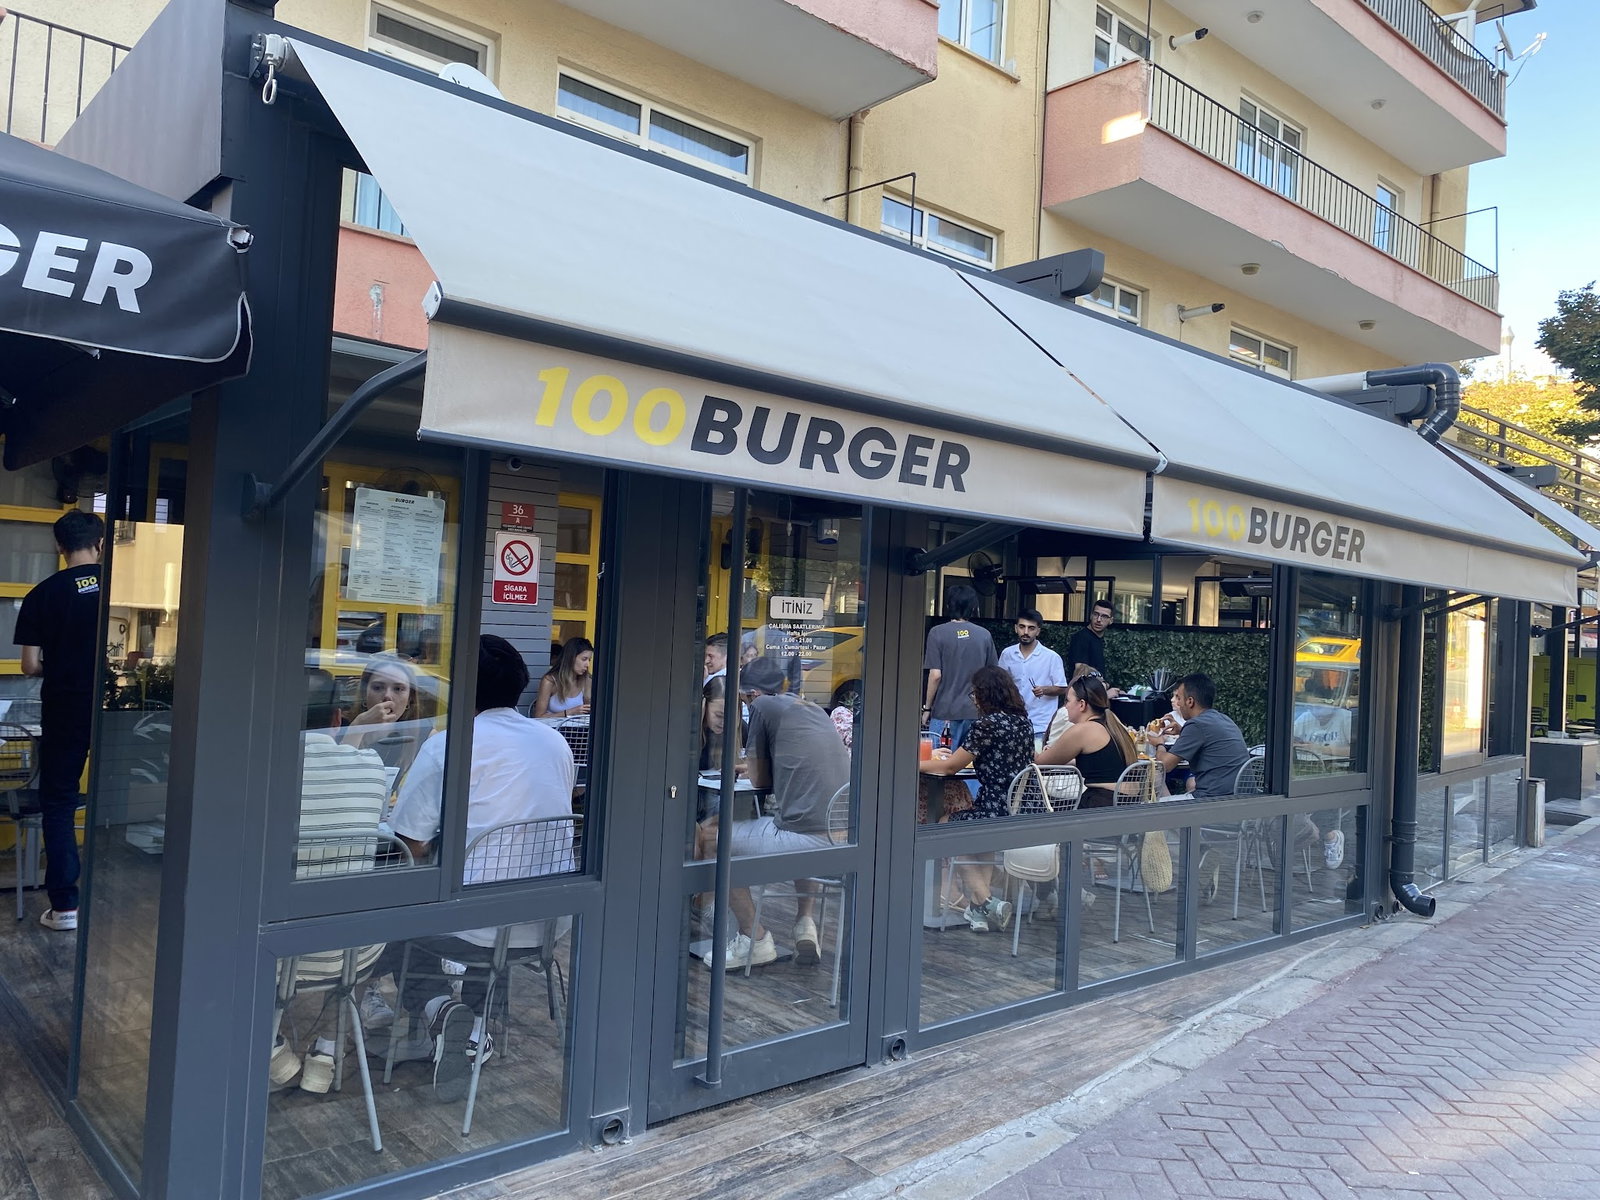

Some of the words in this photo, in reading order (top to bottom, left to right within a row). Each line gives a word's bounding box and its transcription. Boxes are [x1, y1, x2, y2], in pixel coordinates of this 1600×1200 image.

[512, 504, 524, 515] 36
[76, 576, 98, 588] 100
[503, 584, 527, 592] SİGARA
[503, 592, 528, 601] İÇİLMEZ
[782, 600, 812, 614] İTİNİZ
